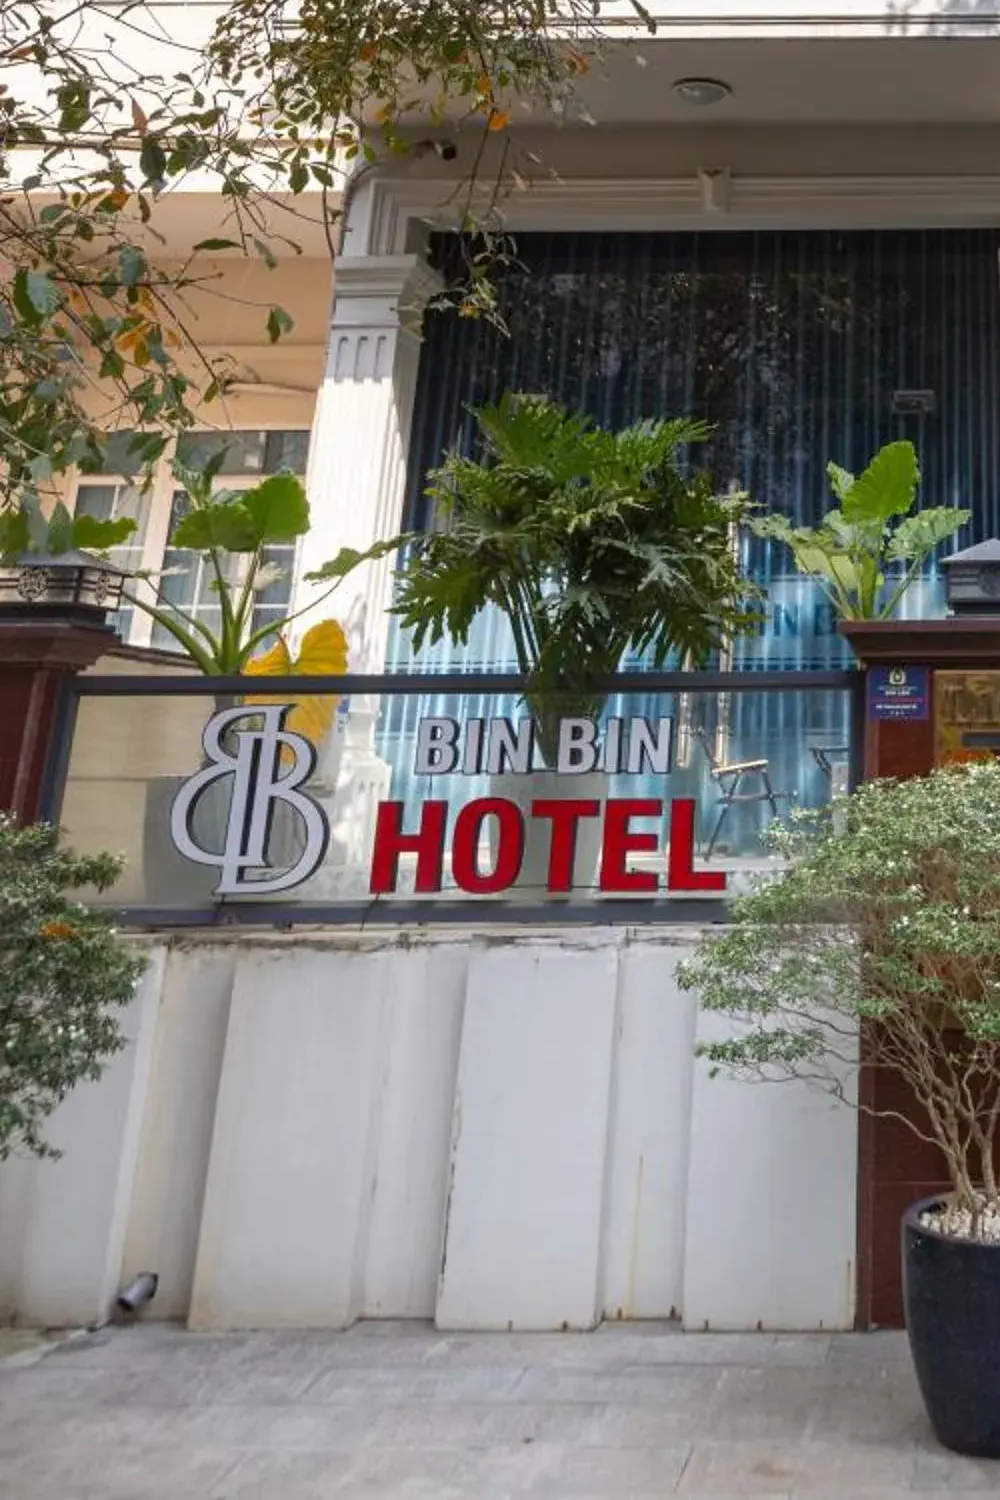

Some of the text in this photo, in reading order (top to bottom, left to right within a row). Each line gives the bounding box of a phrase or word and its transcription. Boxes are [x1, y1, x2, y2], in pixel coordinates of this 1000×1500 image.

[414, 717, 673, 775] BIN BIN
[369, 797, 727, 895] HOTEL
